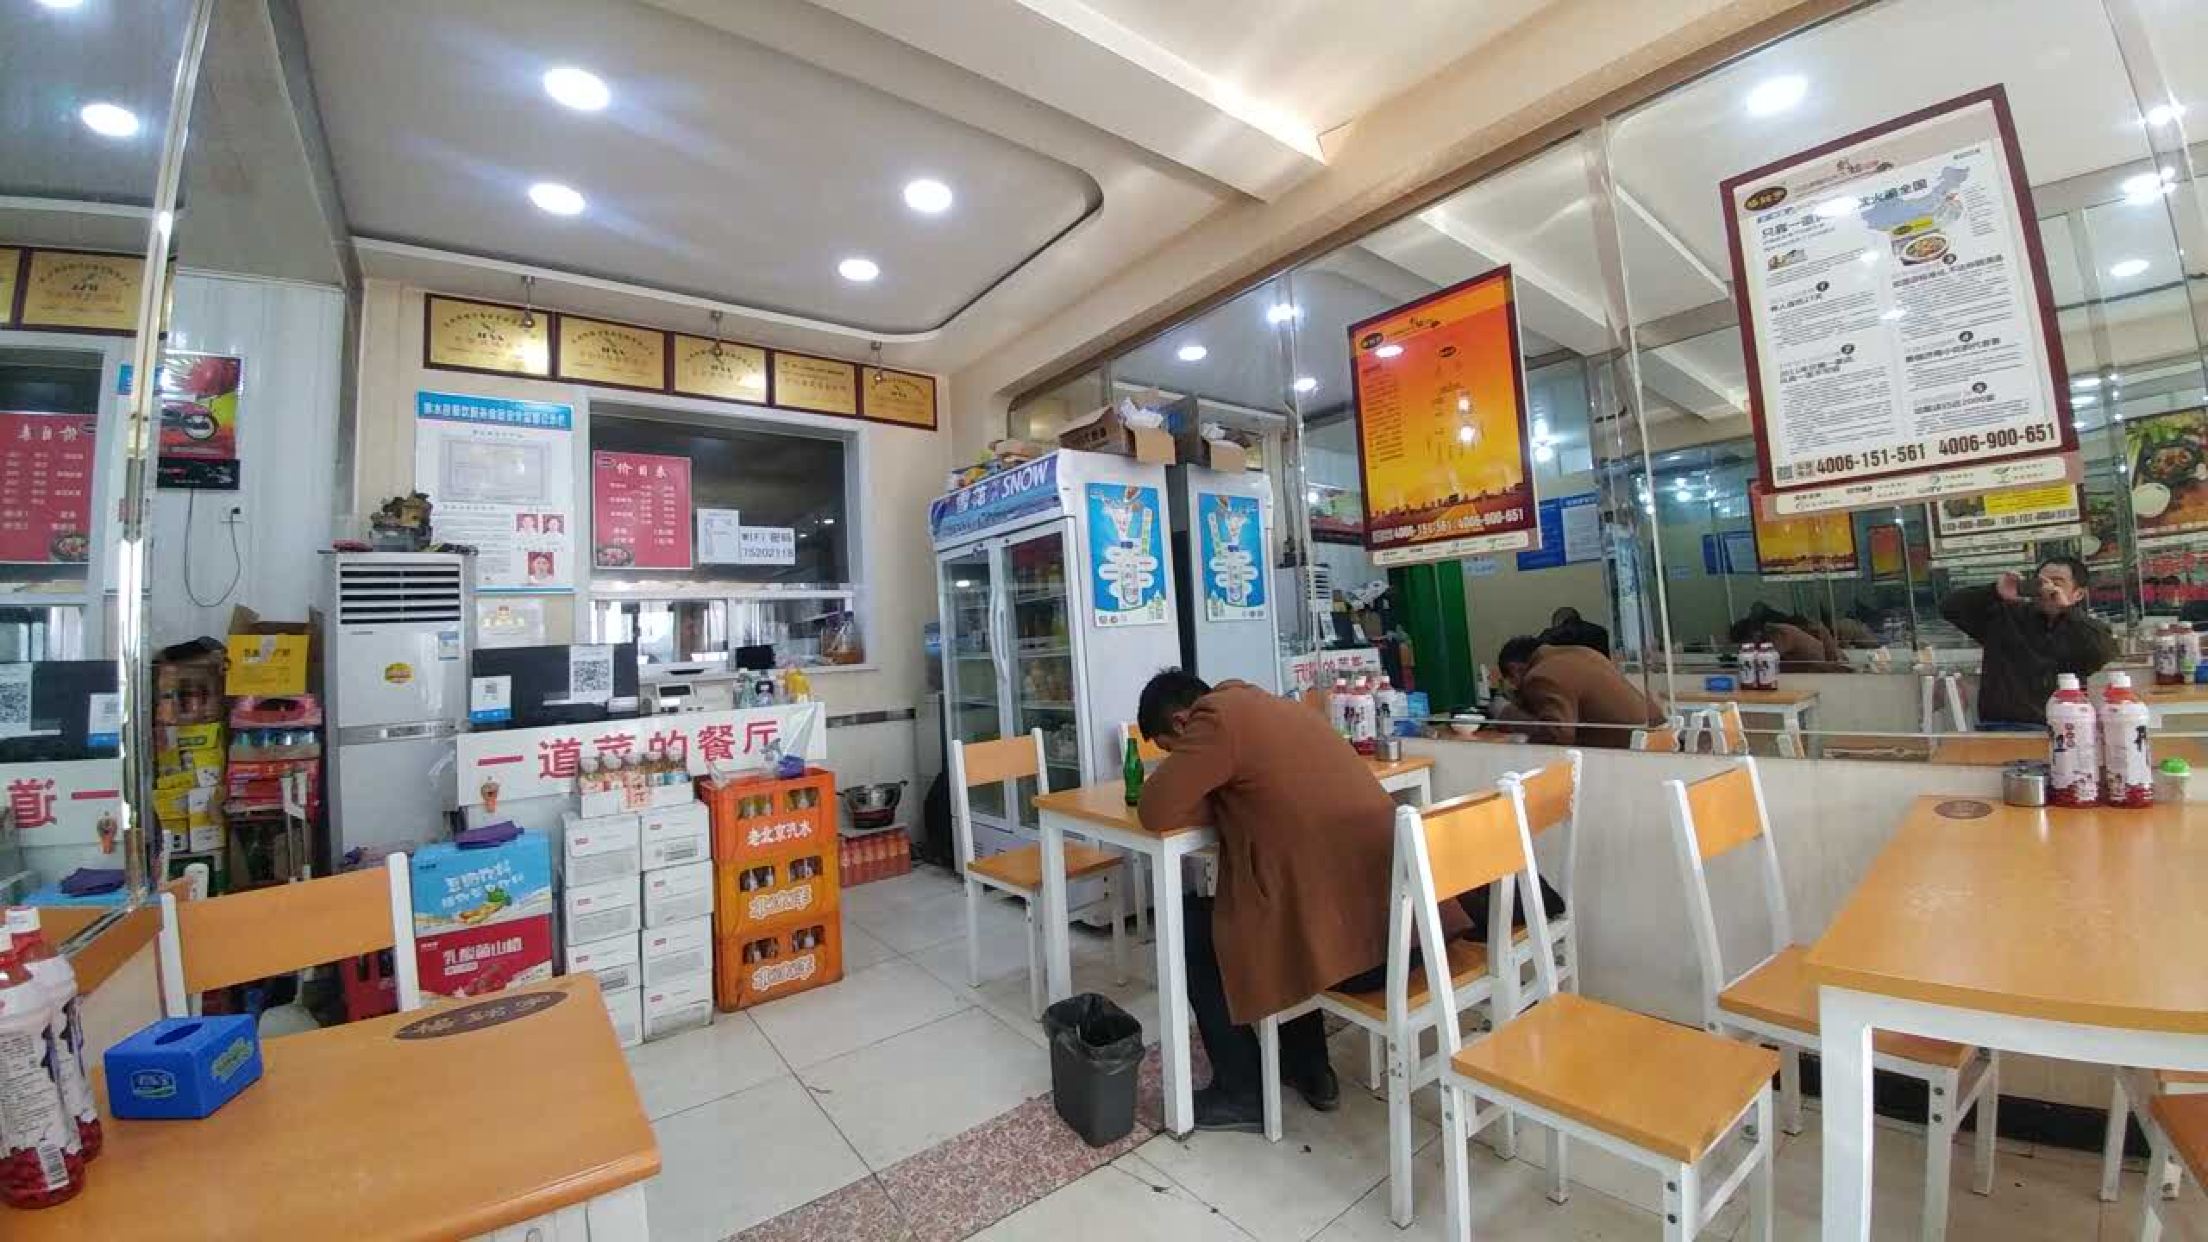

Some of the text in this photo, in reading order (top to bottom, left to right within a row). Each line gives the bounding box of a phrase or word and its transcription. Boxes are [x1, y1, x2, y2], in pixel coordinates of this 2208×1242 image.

[1817, 443, 1926, 474] 4006-151-561
[1938, 422, 2056, 456] 4006-900-651
[1001, 460, 1050, 498] SNOW
